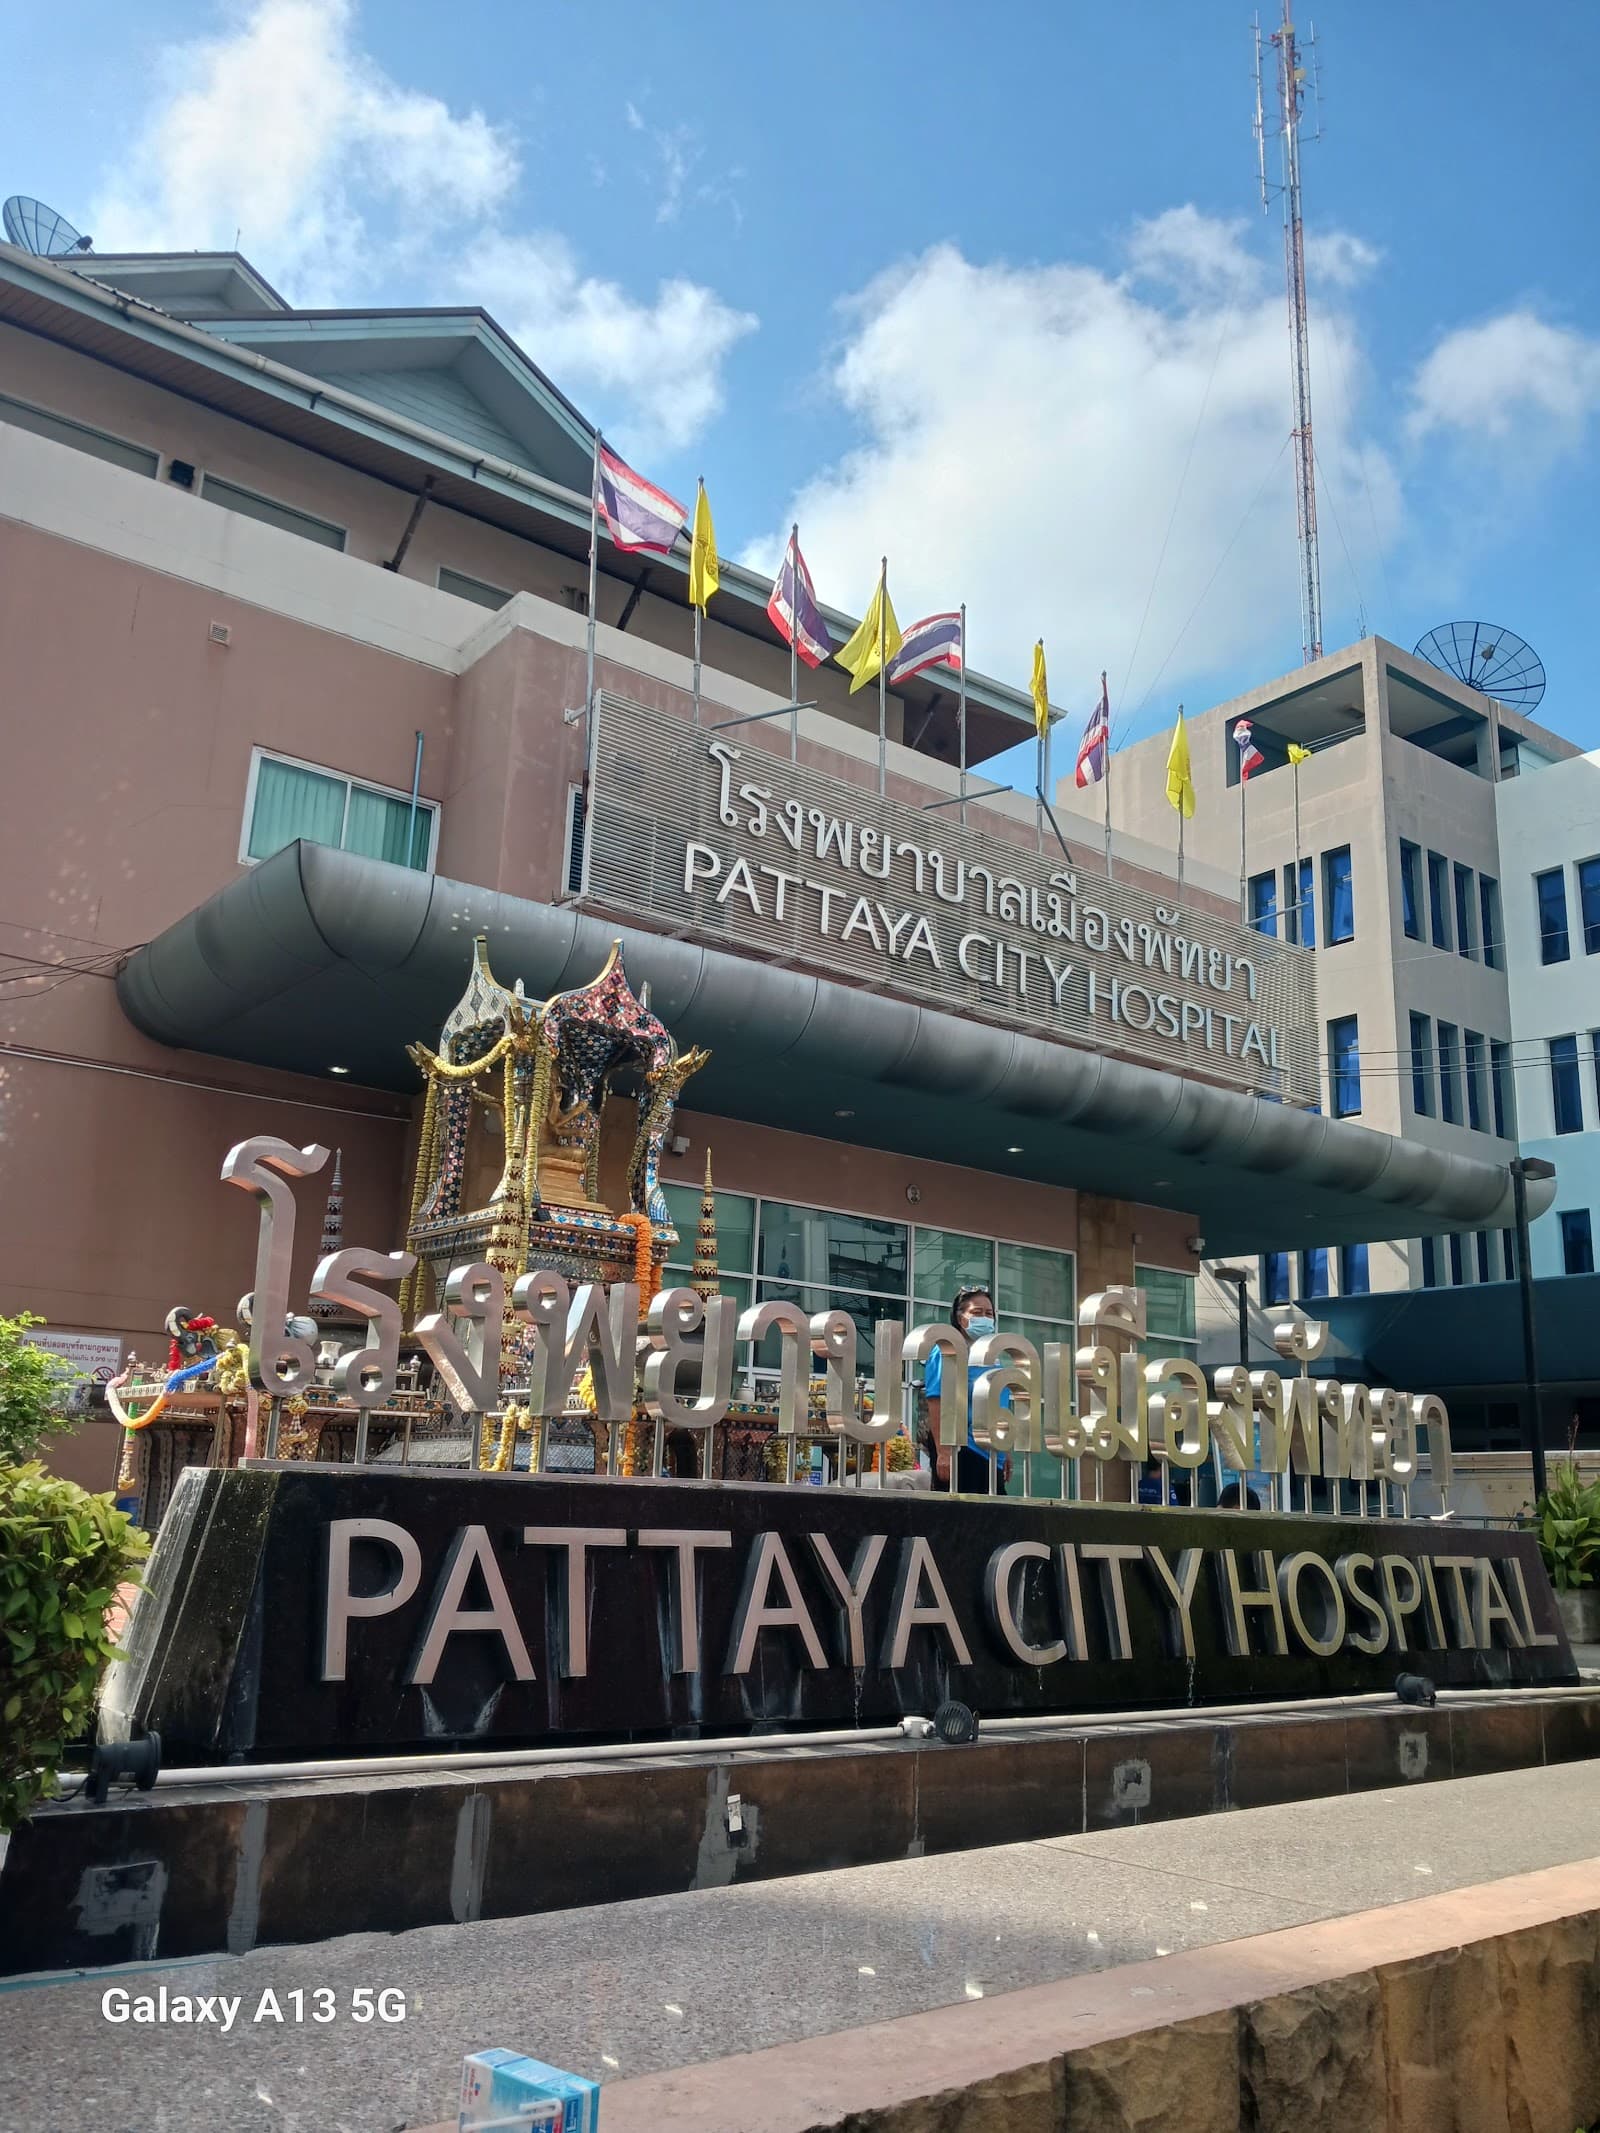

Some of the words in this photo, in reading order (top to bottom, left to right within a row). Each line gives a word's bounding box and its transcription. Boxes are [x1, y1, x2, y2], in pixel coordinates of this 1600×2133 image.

[684, 842, 942, 970] PATTAYA
[958, 933, 1075, 1005] CITY
[1088, 970, 1291, 1072] HOSPITAL
[709, 742, 1257, 1001] โรงพยาบาลเมืองพัทยา
[220, 1135, 1453, 1487] โรงพยาบาลเมืองพัทยา
[321, 1518, 972, 1684] PATTAYA
[986, 1541, 1203, 1665] CITY
[1219, 1549, 1558, 1657] HOSPITAL
